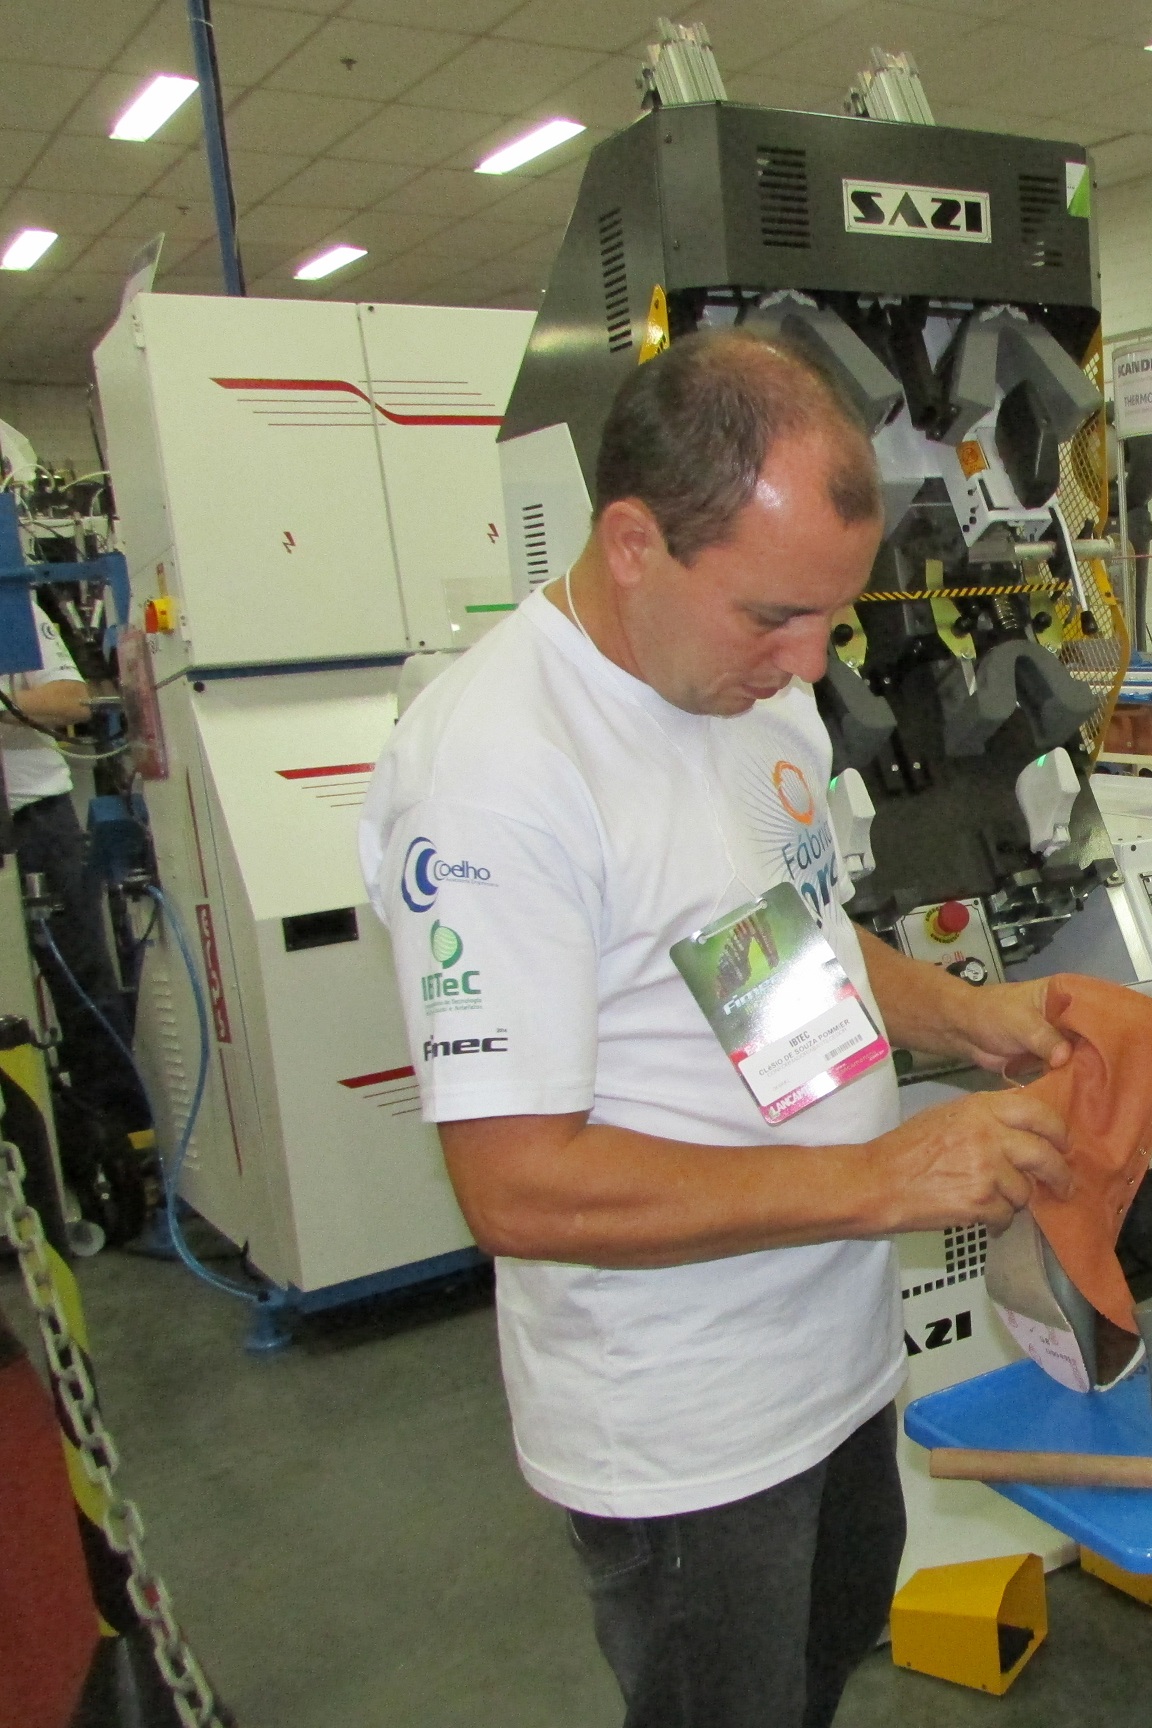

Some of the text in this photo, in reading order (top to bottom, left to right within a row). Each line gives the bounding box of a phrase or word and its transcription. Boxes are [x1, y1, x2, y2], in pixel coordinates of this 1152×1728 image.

[850, 191, 983, 233] SAZI
[433, 859, 491, 881] Coelho
[783, 1051, 794, 1062] DE
[794, 1038, 818, 1055] SOUZA
[789, 1030, 810, 1048] IBTEC
